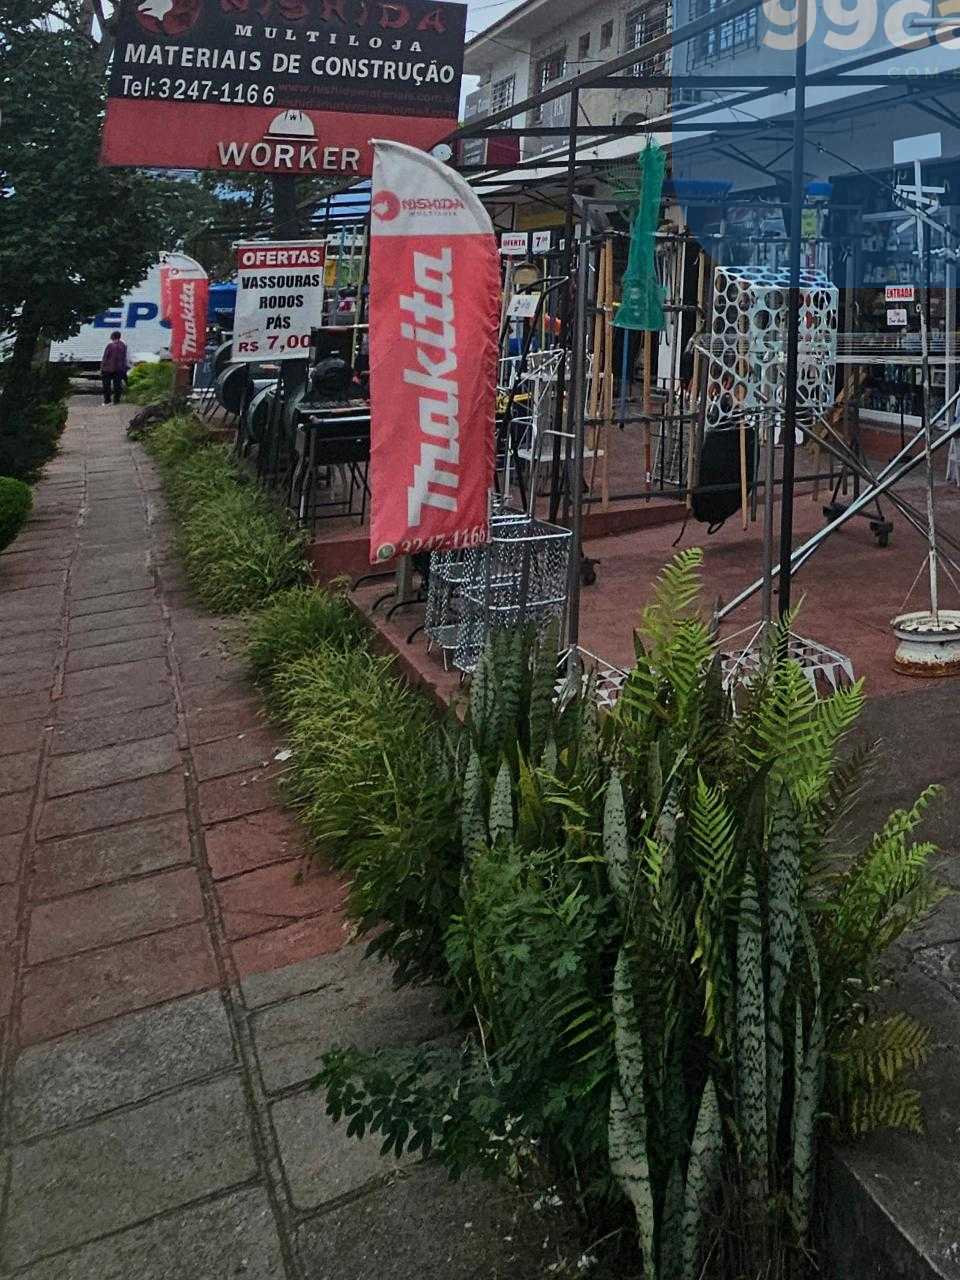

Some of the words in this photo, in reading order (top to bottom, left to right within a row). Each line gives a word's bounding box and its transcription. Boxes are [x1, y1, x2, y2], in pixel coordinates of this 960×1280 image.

[234, 23, 423, 53] MULTILOJA
[124, 43, 262, 72] MATERIAIS
[272, 52, 300, 74] DE
[310, 55, 455, 86] CONSTRUÇÃO
[218, 141, 360, 171] WORKER
[400, 197, 464, 210] NISHIDA
[503, 239, 526, 247] OFERTA
[242, 249, 321, 266] OFERTAS
[241, 274, 320, 290] VASSOURAS
[258, 294, 304, 310] RODOS
[886, 288, 913, 299] ENTRADA
[94, 301, 172, 329] EP
[179, 281, 197, 356] makita
[266, 313, 291, 330] PÁS
[238, 340, 260, 353] R$
[266, 333, 312, 353] 7,00
[400, 247, 460, 527] makita
